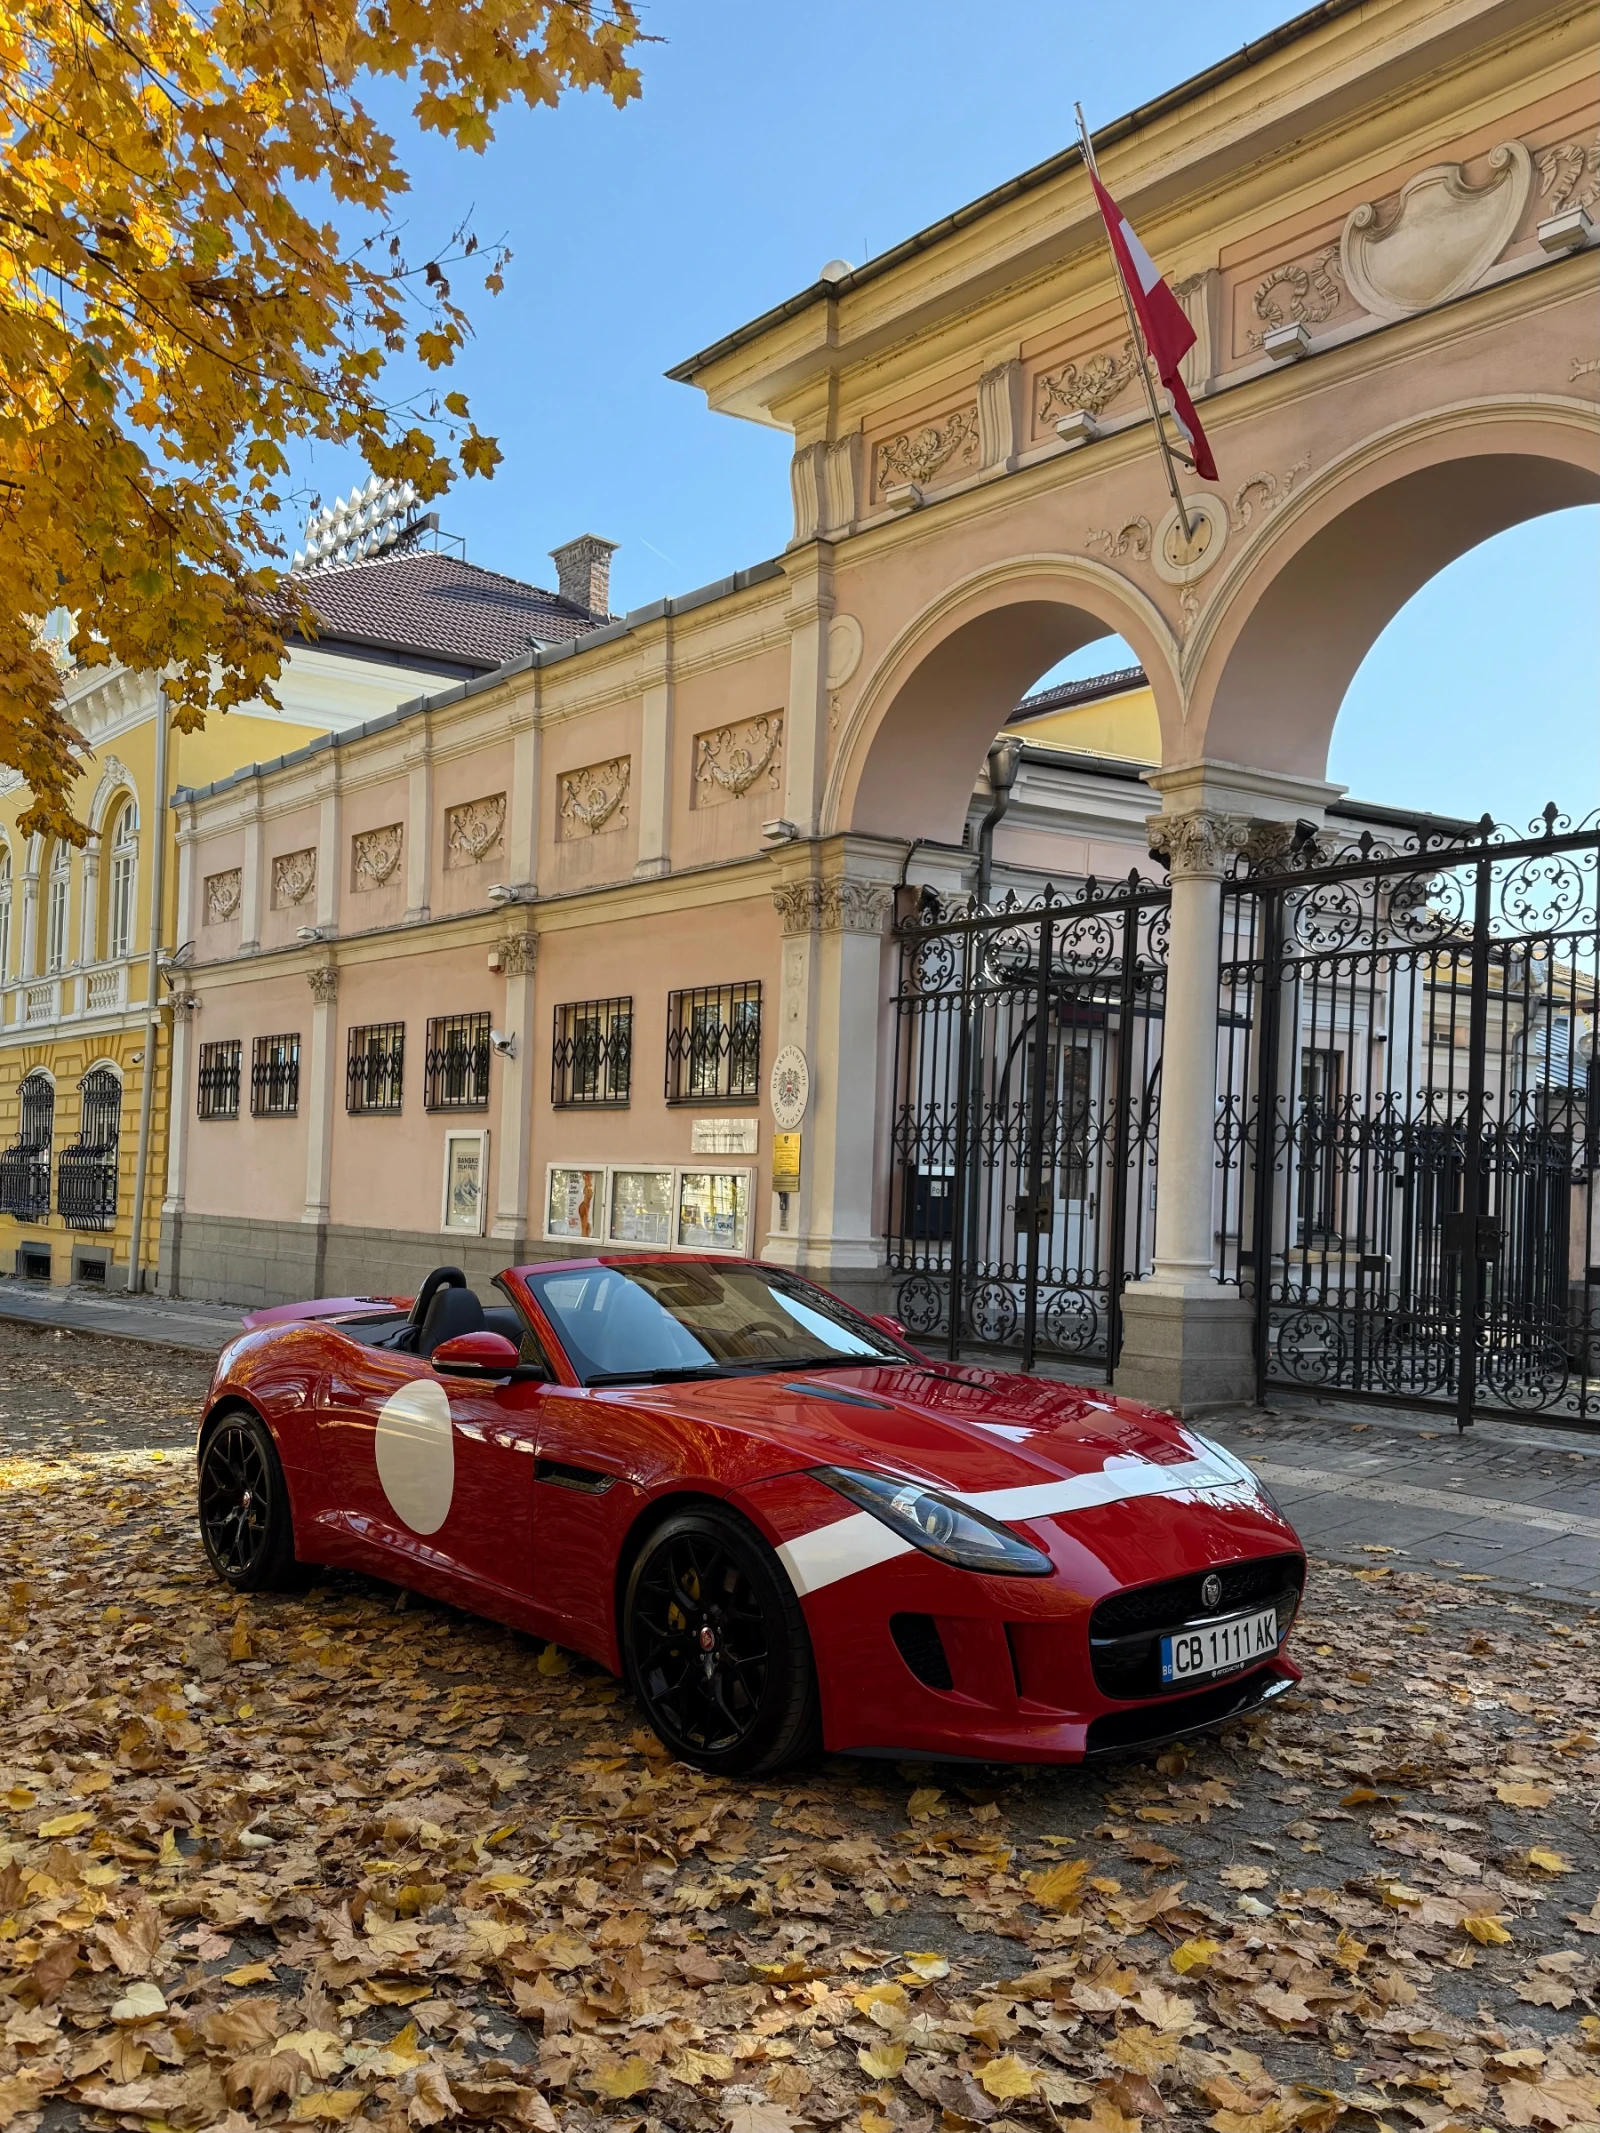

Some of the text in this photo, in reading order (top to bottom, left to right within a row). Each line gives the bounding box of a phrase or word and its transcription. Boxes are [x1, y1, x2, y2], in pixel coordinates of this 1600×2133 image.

[1176, 1613, 1275, 1673] CB 1111 AK
[1162, 1664, 1173, 1676] BG
